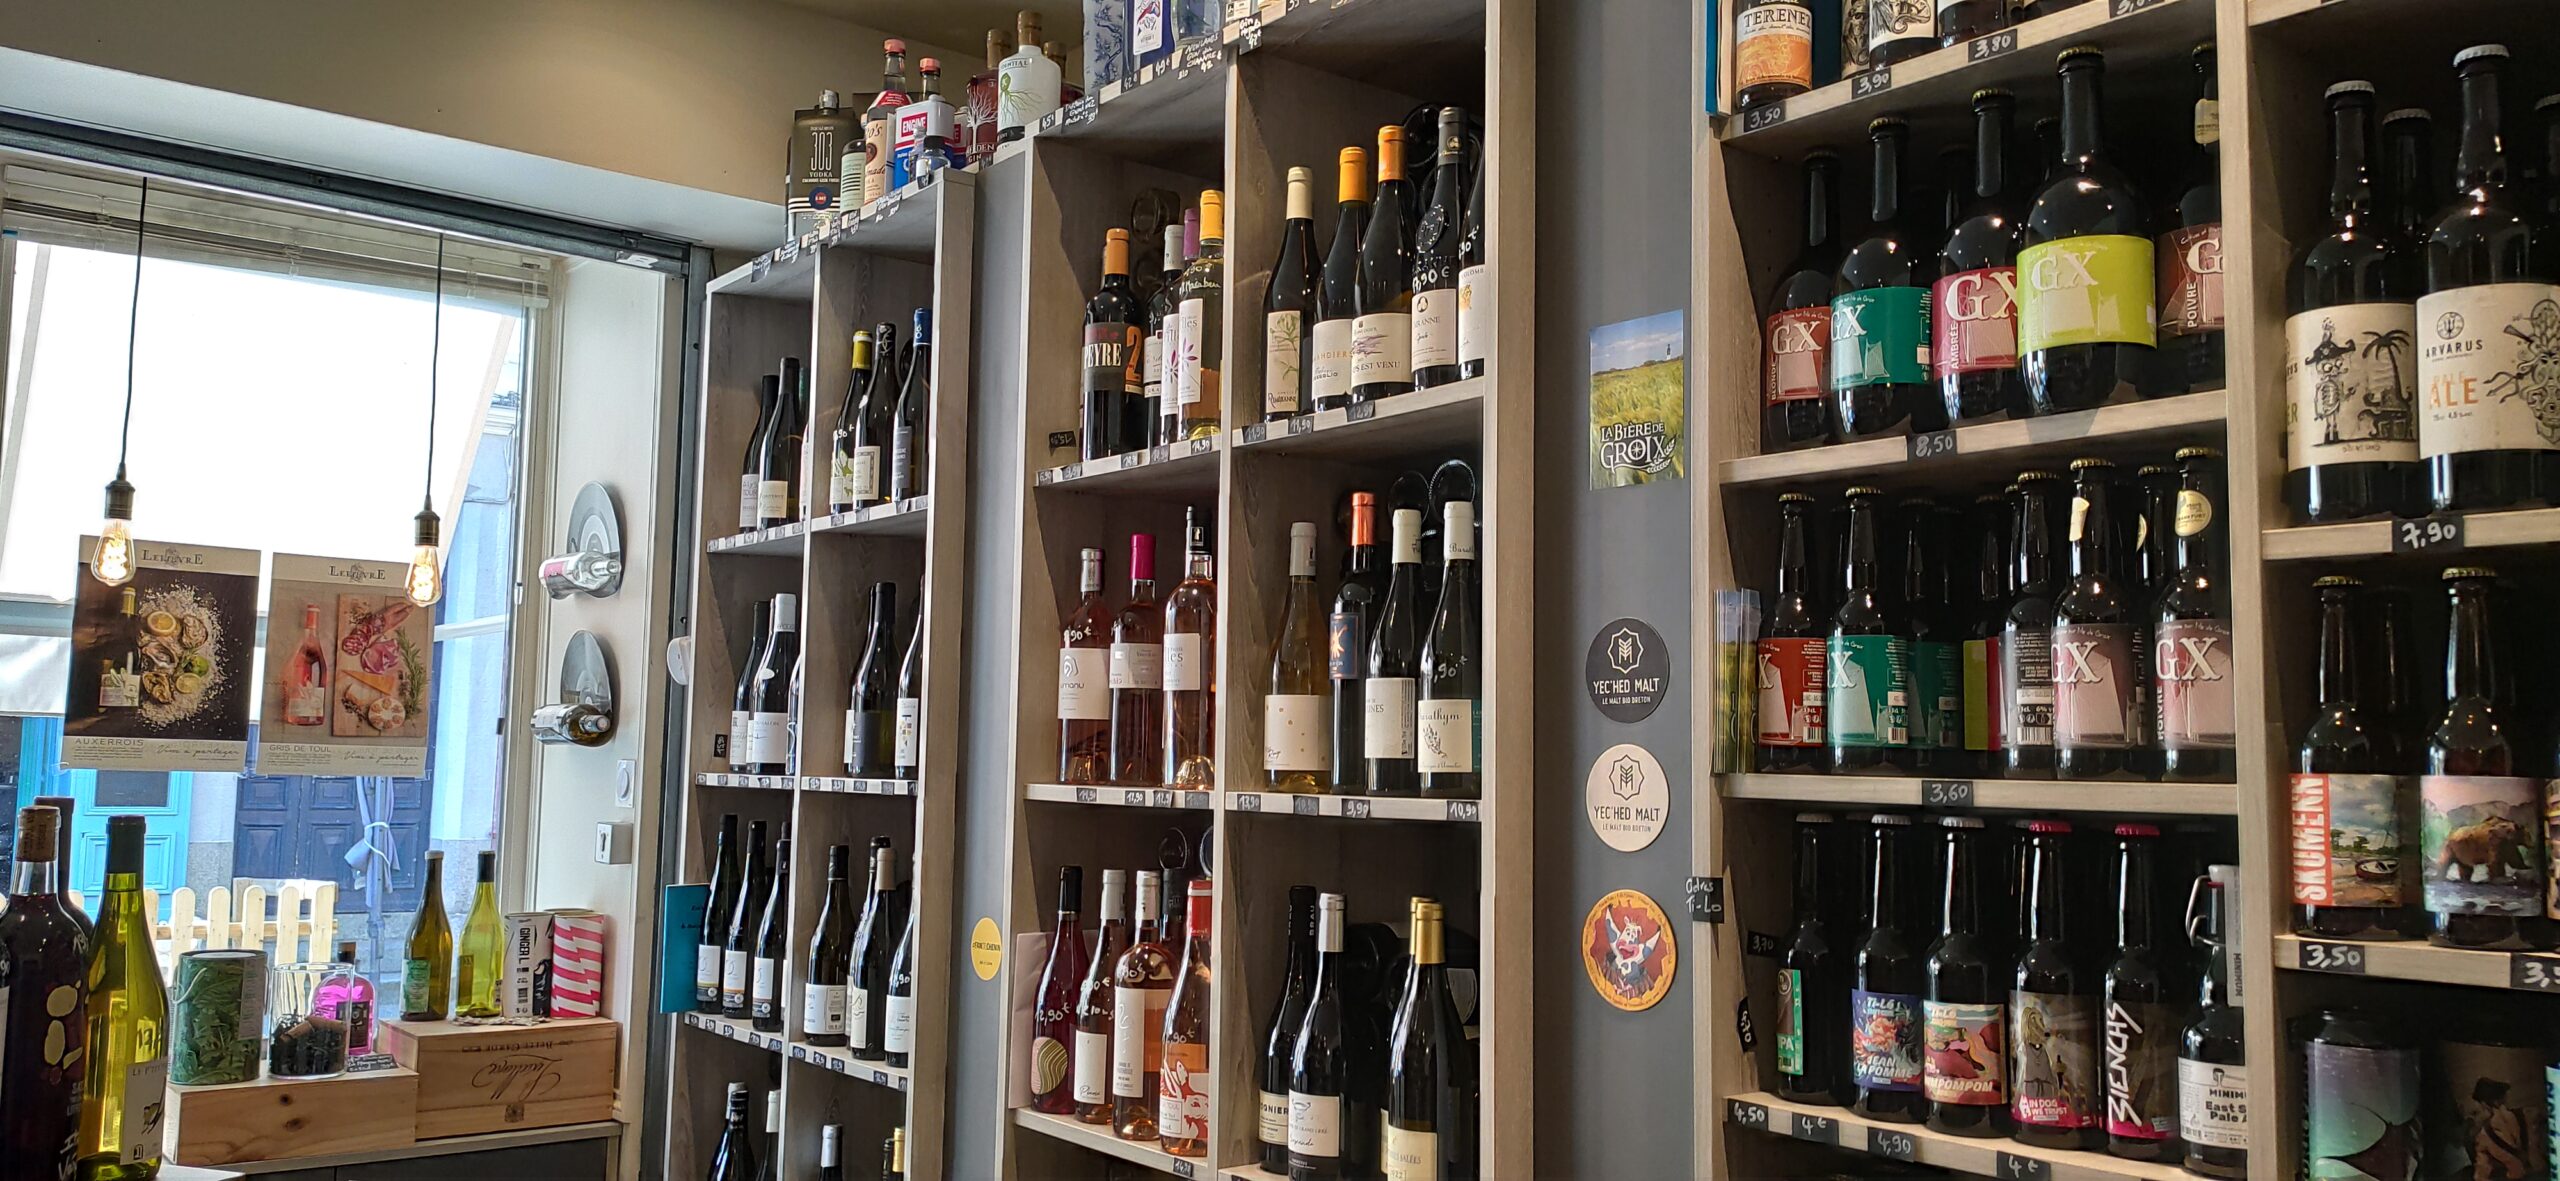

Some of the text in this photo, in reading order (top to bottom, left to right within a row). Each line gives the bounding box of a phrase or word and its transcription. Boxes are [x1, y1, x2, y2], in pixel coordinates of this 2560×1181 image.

[1974, 35, 2011, 59] 3,80
[1858, 73, 1890, 94] 3,90
[1750, 107, 1781, 128] 3,50
[811, 131, 833, 171] 303
[2031, 251, 2098, 292] GX
[1945, 271, 2018, 322] GX
[2187, 282, 2198, 328] POIVRE
[1772, 320, 1822, 354] GX
[1950, 319, 1960, 369] AMBRÉE
[2426, 340, 2483, 358] ARVARUS
[2430, 378, 2480, 409] ALE
[1602, 422, 1664, 442] LA BIÈRE DE
[1601, 436, 1666, 473] GROIX
[1916, 436, 1953, 457] 8,50
[2401, 521, 2456, 549] 7,90
[2051, 642, 2103, 684] GX
[2155, 637, 2223, 681] GX
[1593, 678, 1660, 695] YEC'HED MALT
[1609, 697, 1621, 705] MALT
[1631, 696, 1651, 704] BRETON
[75, 737, 144, 746] AUXERROIS
[269, 744, 291, 752] GRIS
[1929, 783, 1968, 803] 3,60
[1594, 806, 1661, 822] YEC'HED MALT
[2291, 776, 2326, 901] SKUMENN
[519, 927, 531, 956] GINGER
[2306, 944, 2361, 969] 3,50
[1734, 1102, 1765, 1124] 4,50
[2039, 1099, 2058, 1108] DOG
[2044, 1107, 2068, 1115] TRUST
[2205, 1101, 2234, 1113] East
[1802, 1117, 1813, 1135] 4
[2210, 1111, 2239, 1122] Pale
[1877, 1132, 1911, 1155] 4,90
[2008, 1155, 2022, 1179] 4
